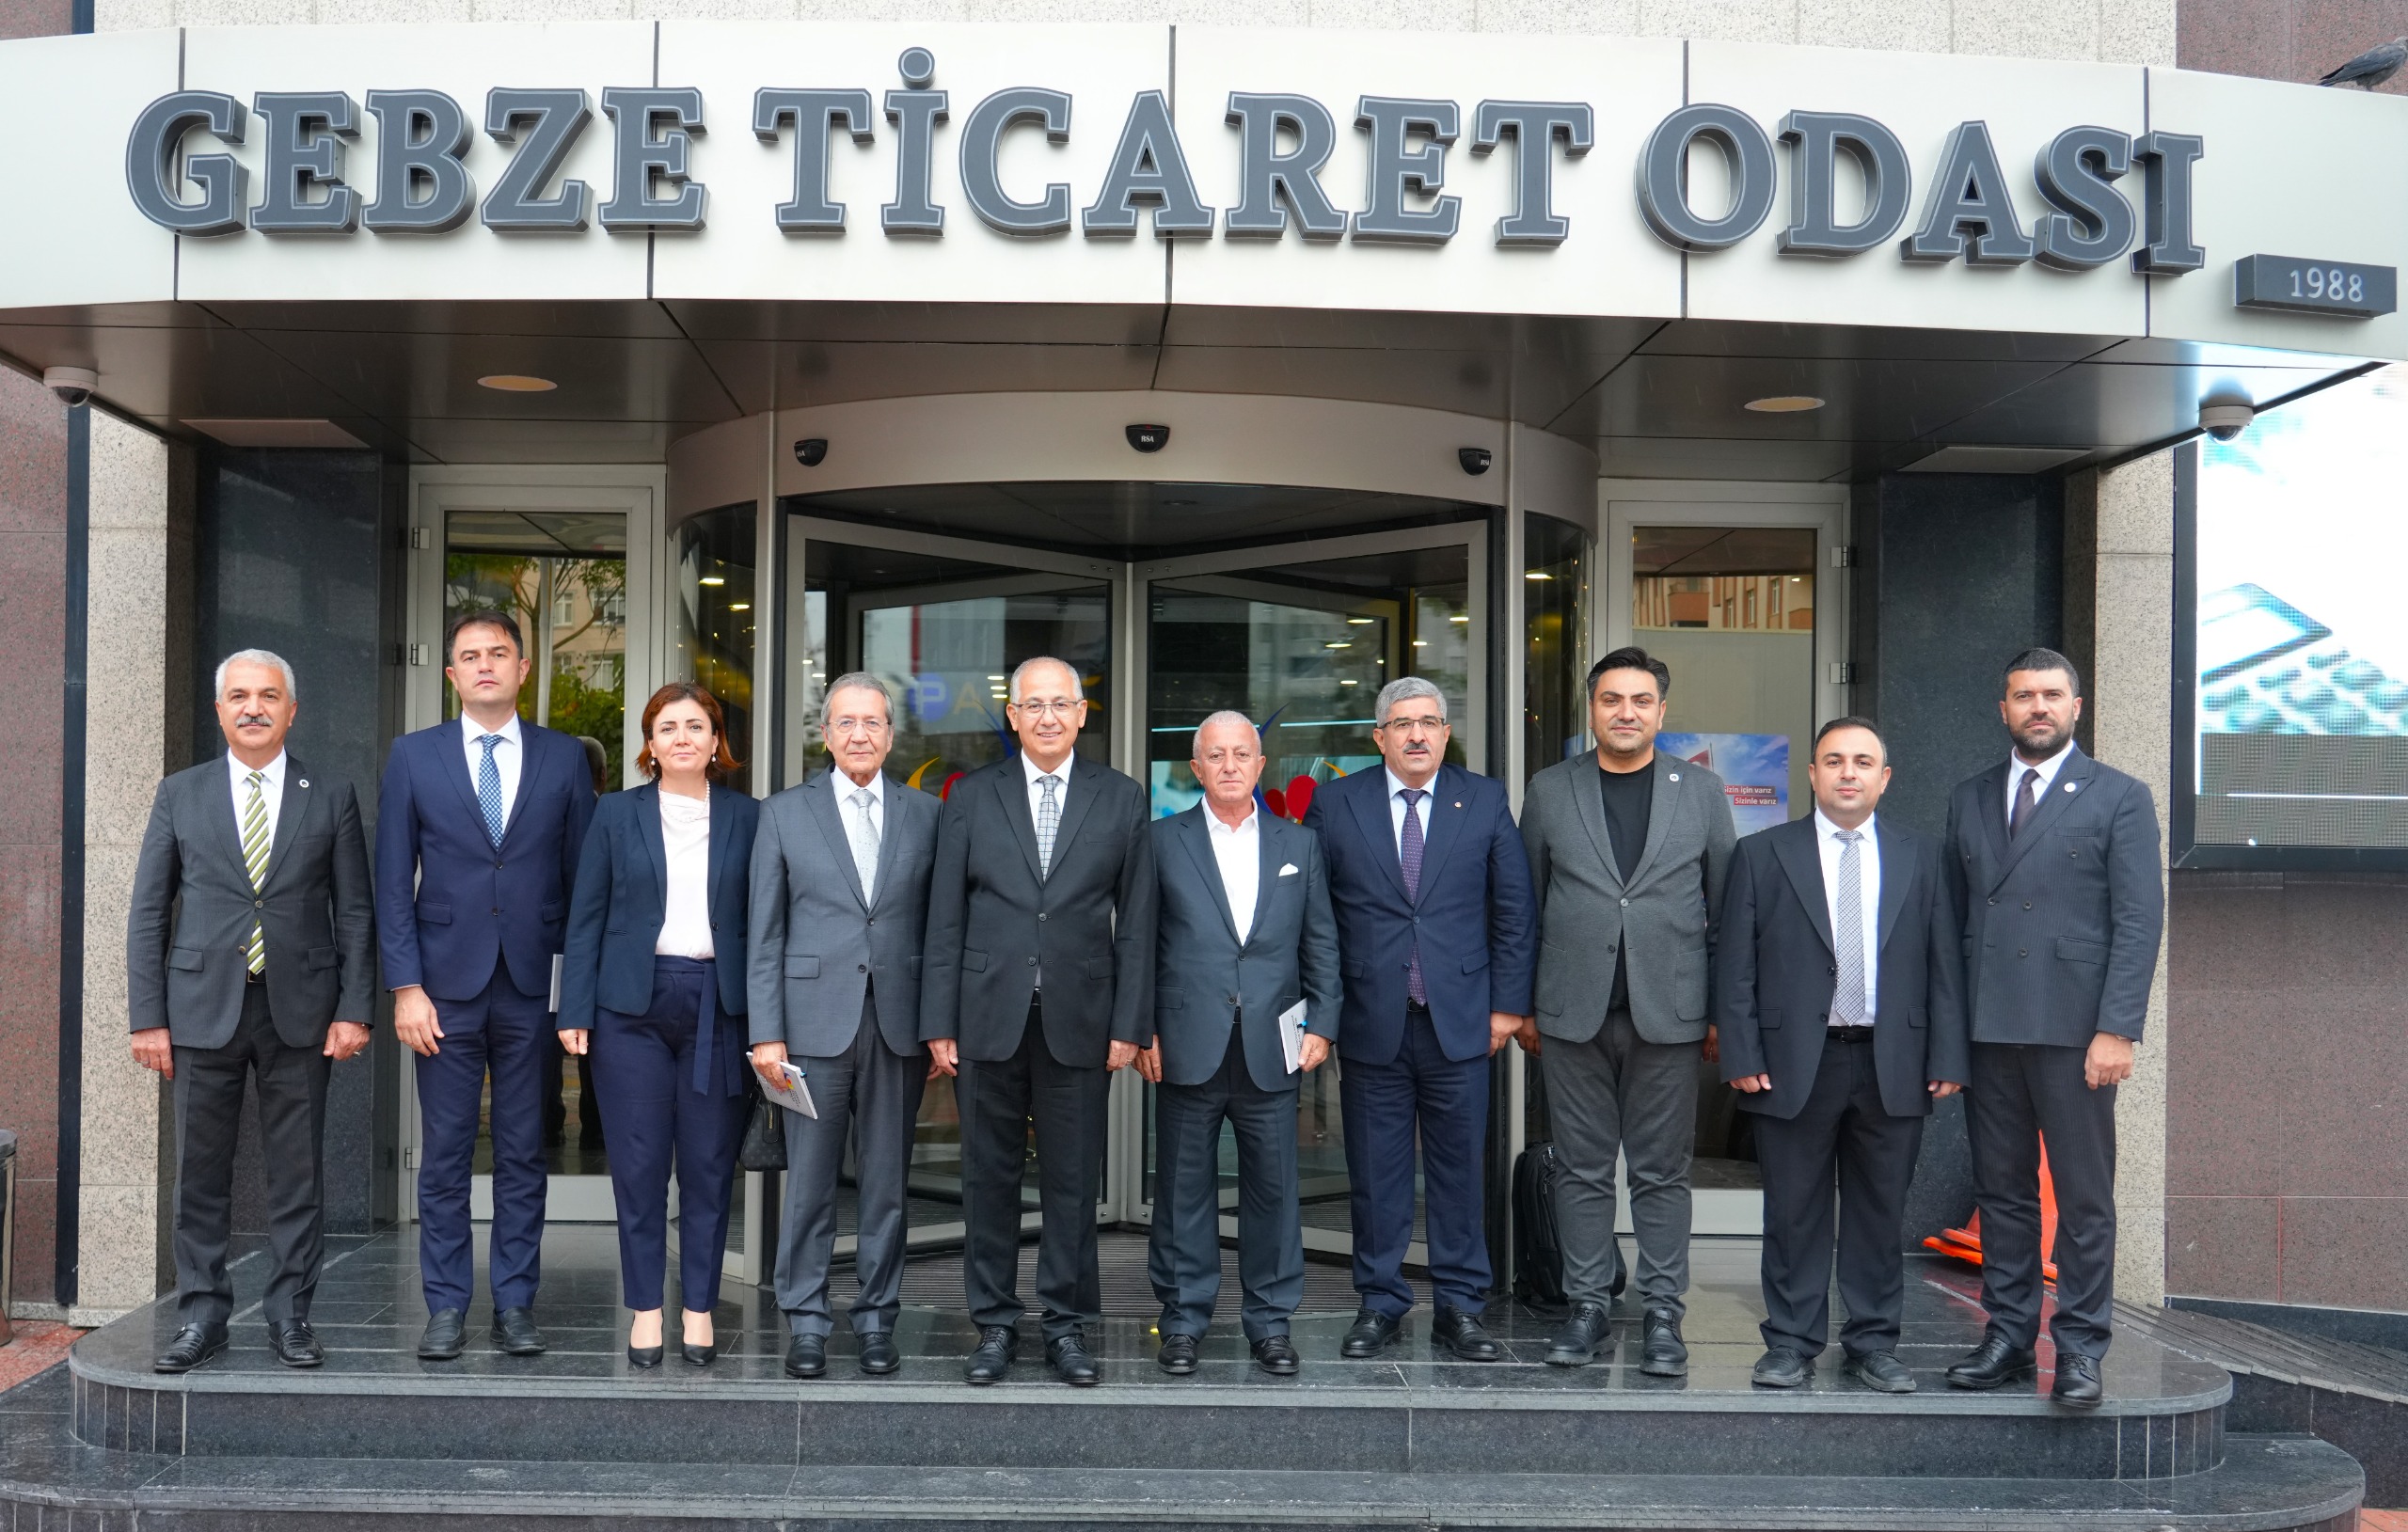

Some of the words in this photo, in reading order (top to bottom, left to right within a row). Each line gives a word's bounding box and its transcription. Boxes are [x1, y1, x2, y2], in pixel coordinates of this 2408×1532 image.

[126, 87, 708, 235] GEBZE
[753, 46, 1594, 247] TİCARET
[1635, 103, 2204, 274] ODASI
[2289, 266, 2364, 303] 1988
[1140, 434, 1155, 443] RSA
[1740, 785, 1753, 795] için
[1735, 797, 1758, 805] Sizinle
